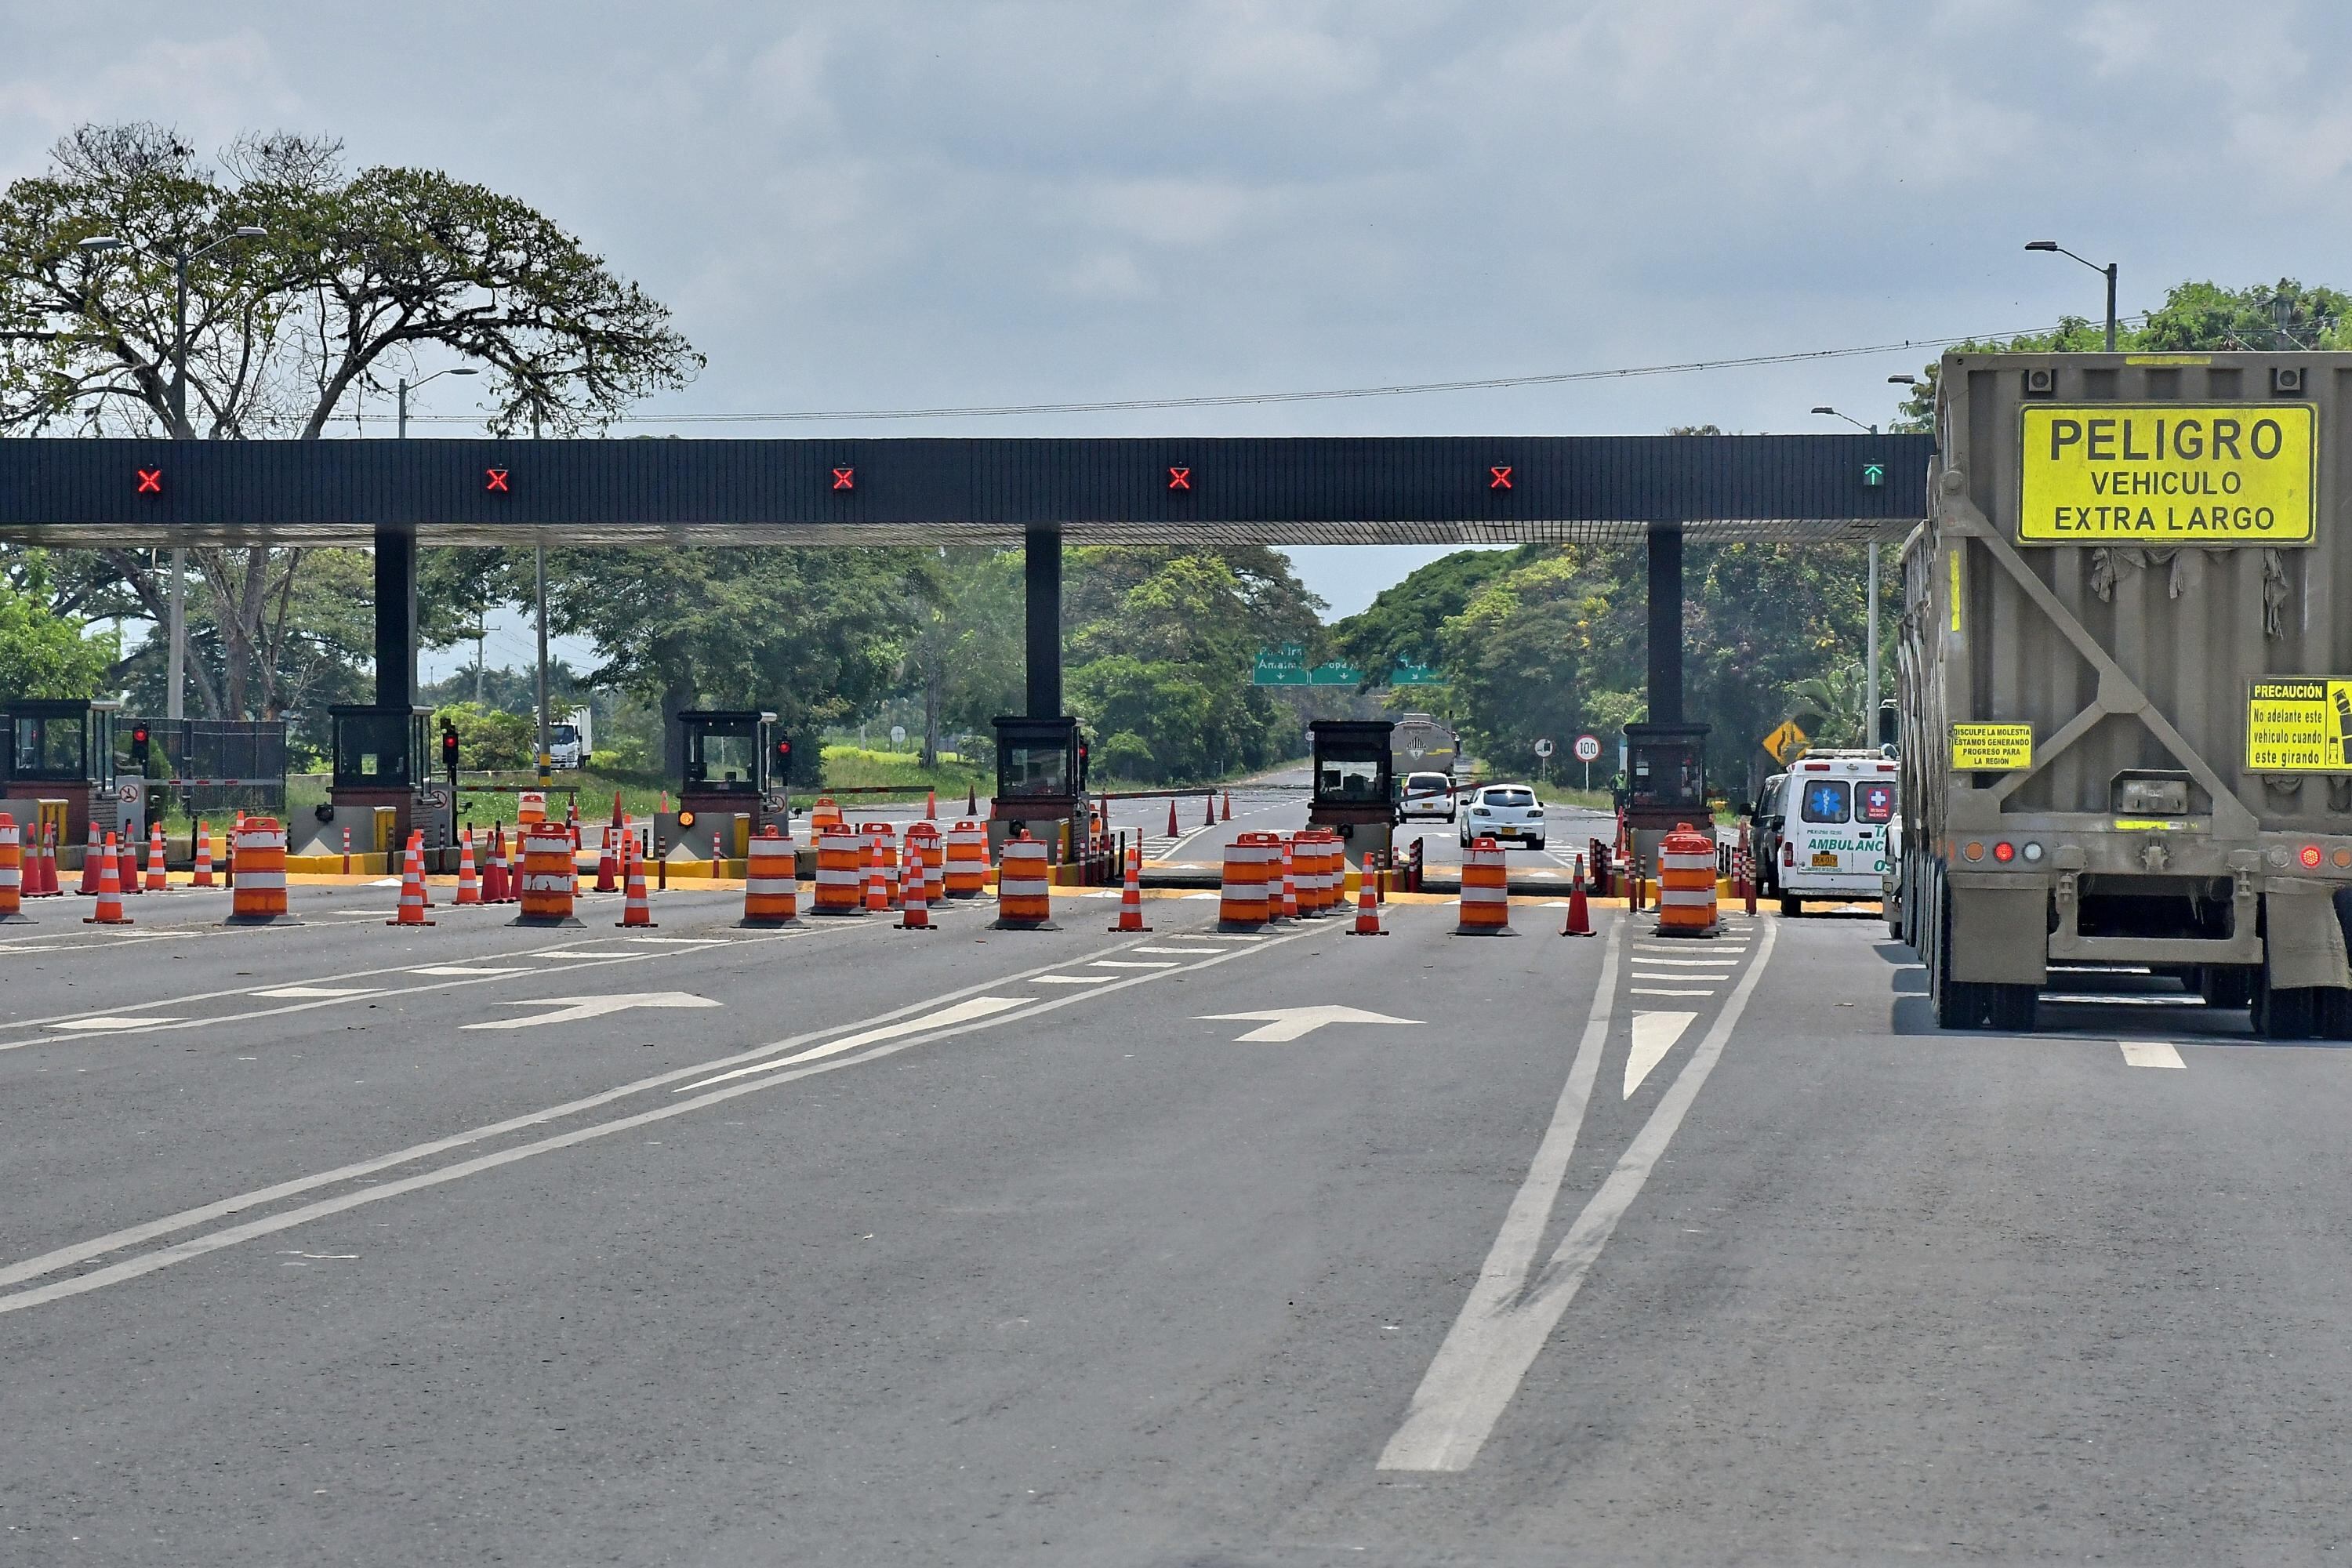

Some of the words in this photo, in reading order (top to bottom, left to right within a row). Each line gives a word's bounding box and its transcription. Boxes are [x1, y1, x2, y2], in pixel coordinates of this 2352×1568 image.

[2050, 418, 2282, 460] PELIGRO
[2091, 471, 2241, 495] VEHICULO
[2055, 506, 2155, 530] EXTRA
[2168, 506, 2274, 530] LARGO
[2254, 683, 2323, 699] PRECAUCIÓN
[2254, 708, 2263, 723] No
[2267, 708, 2302, 723] adelante
[2305, 710, 2322, 723] este
[2292, 729, 2321, 744] cuando
[1580, 742, 1596, 754] 100
[2255, 750, 2277, 764] este
[2281, 750, 2319, 767] girando
[1807, 838, 1886, 851] AMBULANC
